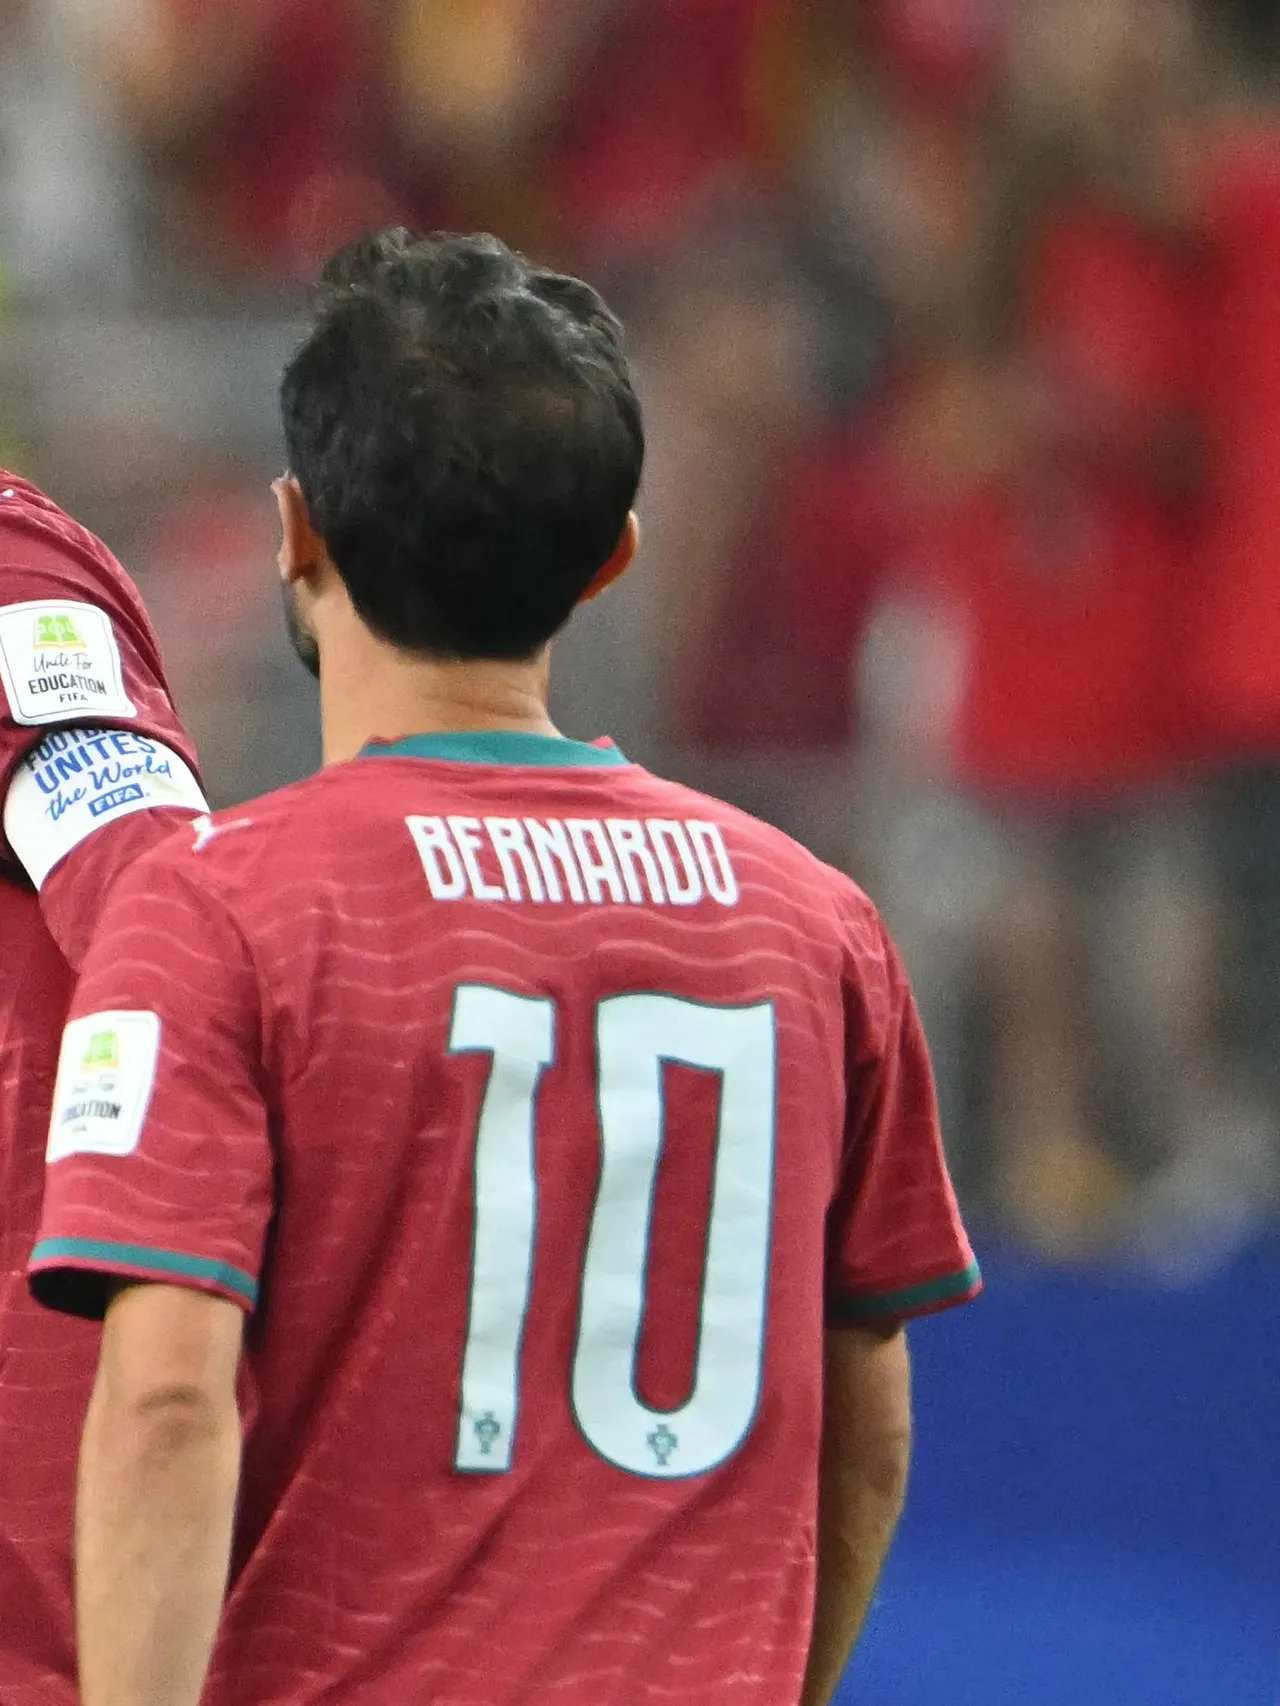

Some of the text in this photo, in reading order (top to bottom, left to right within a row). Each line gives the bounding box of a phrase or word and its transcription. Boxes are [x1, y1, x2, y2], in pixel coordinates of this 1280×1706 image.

[28, 673, 107, 695] EDUCATION
[59, 692, 88, 702] FIFA
[34, 734, 157, 794] UNITES
[45, 755, 172, 821] the World
[92, 785, 140, 813] FIFA
[404, 815, 739, 908] BERNARDO
[447, 982, 777, 1481] 10
